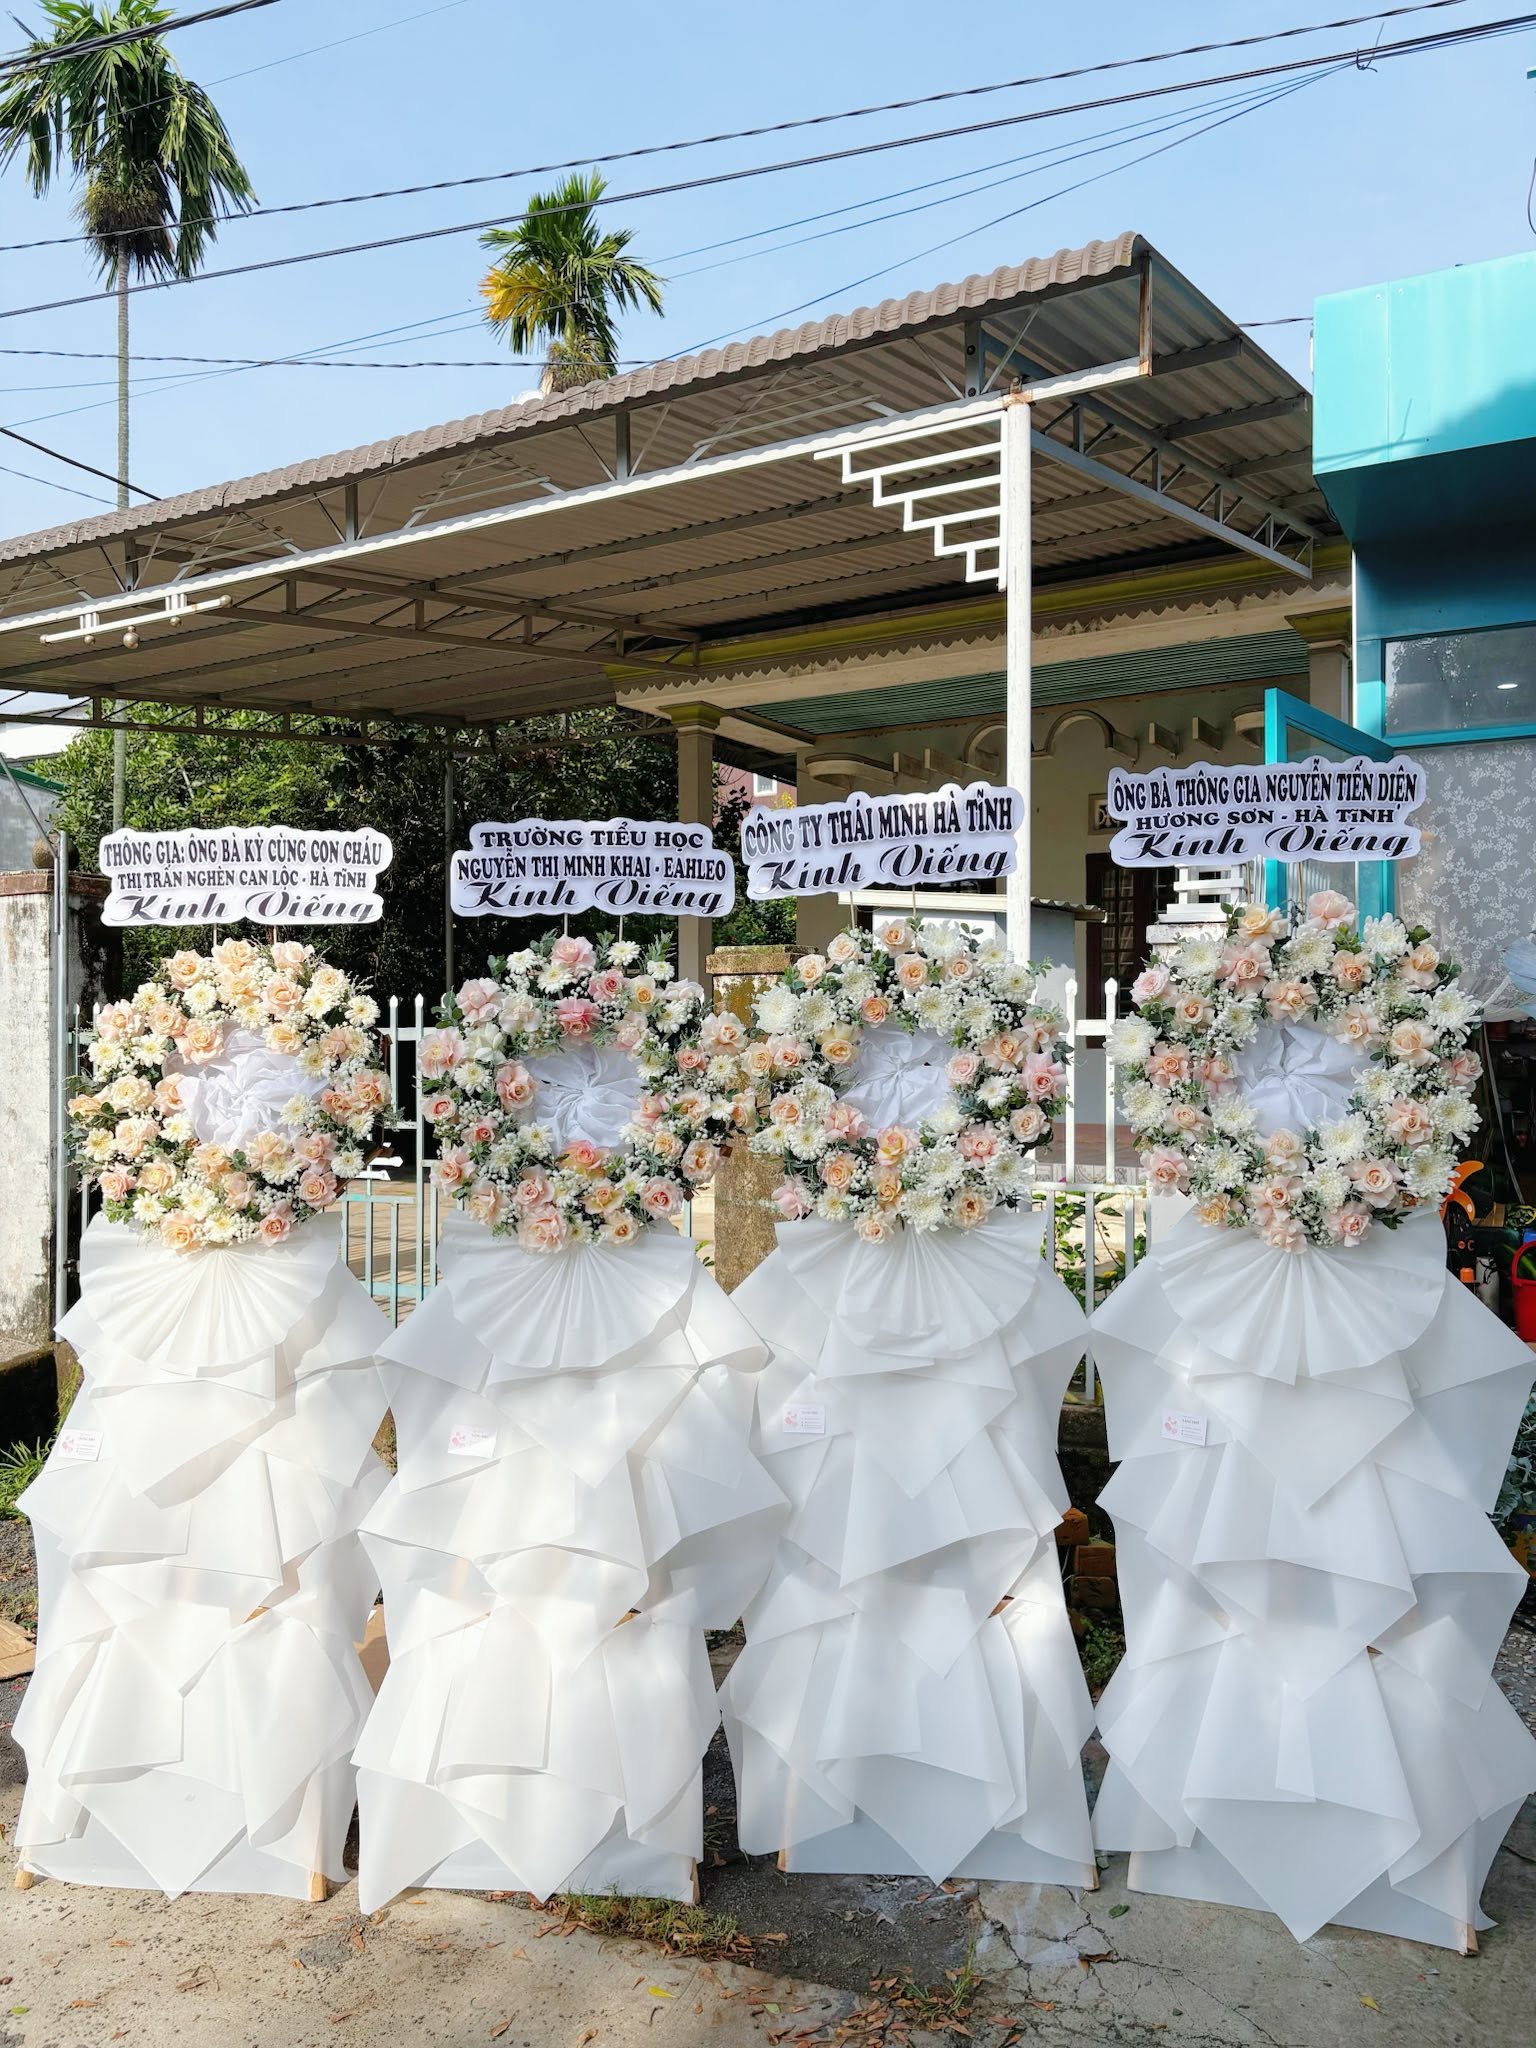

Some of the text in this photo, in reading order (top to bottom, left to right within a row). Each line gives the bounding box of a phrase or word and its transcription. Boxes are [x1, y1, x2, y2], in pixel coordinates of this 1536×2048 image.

[1113, 777, 1146, 812] ÔNG
[1150, 772, 1173, 809] BÀ
[1176, 770, 1228, 806] THÔNG
[1234, 775, 1261, 803] GIA
[1265, 758, 1332, 802] NGUYỄN
[1336, 760, 1374, 801] TIẾN
[745, 814, 795, 857] CÔNG
[799, 814, 822, 848] TY
[879, 802, 928, 838] MINH
[933, 791, 961, 834] HÀ
[1136, 811, 1220, 830] HƯƠNG
[1227, 808, 1274, 825] SƠN
[1295, 805, 1328, 824] HÀ
[104, 835, 151, 867] THÔNG
[189, 833, 217, 863] ÔNG
[222, 832, 241, 862] BÀ
[268, 833, 307, 862] CÙNG
[311, 840, 339, 863] CON
[343, 835, 382, 865] CHÁU
[480, 822, 704, 851] TRƯỜNG TIỂU HỌC
[1120, 826, 1413, 860] Kính Viếng
[118, 874, 143, 892] THỊ
[144, 865, 182, 888] TRẤN
[187, 867, 235, 886] NGHÈN
[239, 870, 268, 886] CAN
[272, 865, 299, 890] LỘC
[310, 867, 330, 886] HÀ
[458, 847, 526, 880] NGUYỄN
[531, 856, 559, 880] THỊ
[564, 856, 604, 877] MINH
[610, 856, 651, 877] KHAI
[664, 858, 725, 881] EAHLEO
[753, 844, 1011, 894] Kính Viếng
[111, 891, 377, 922] Kính Viếng
[459, 878, 725, 914] Kính Viếng
